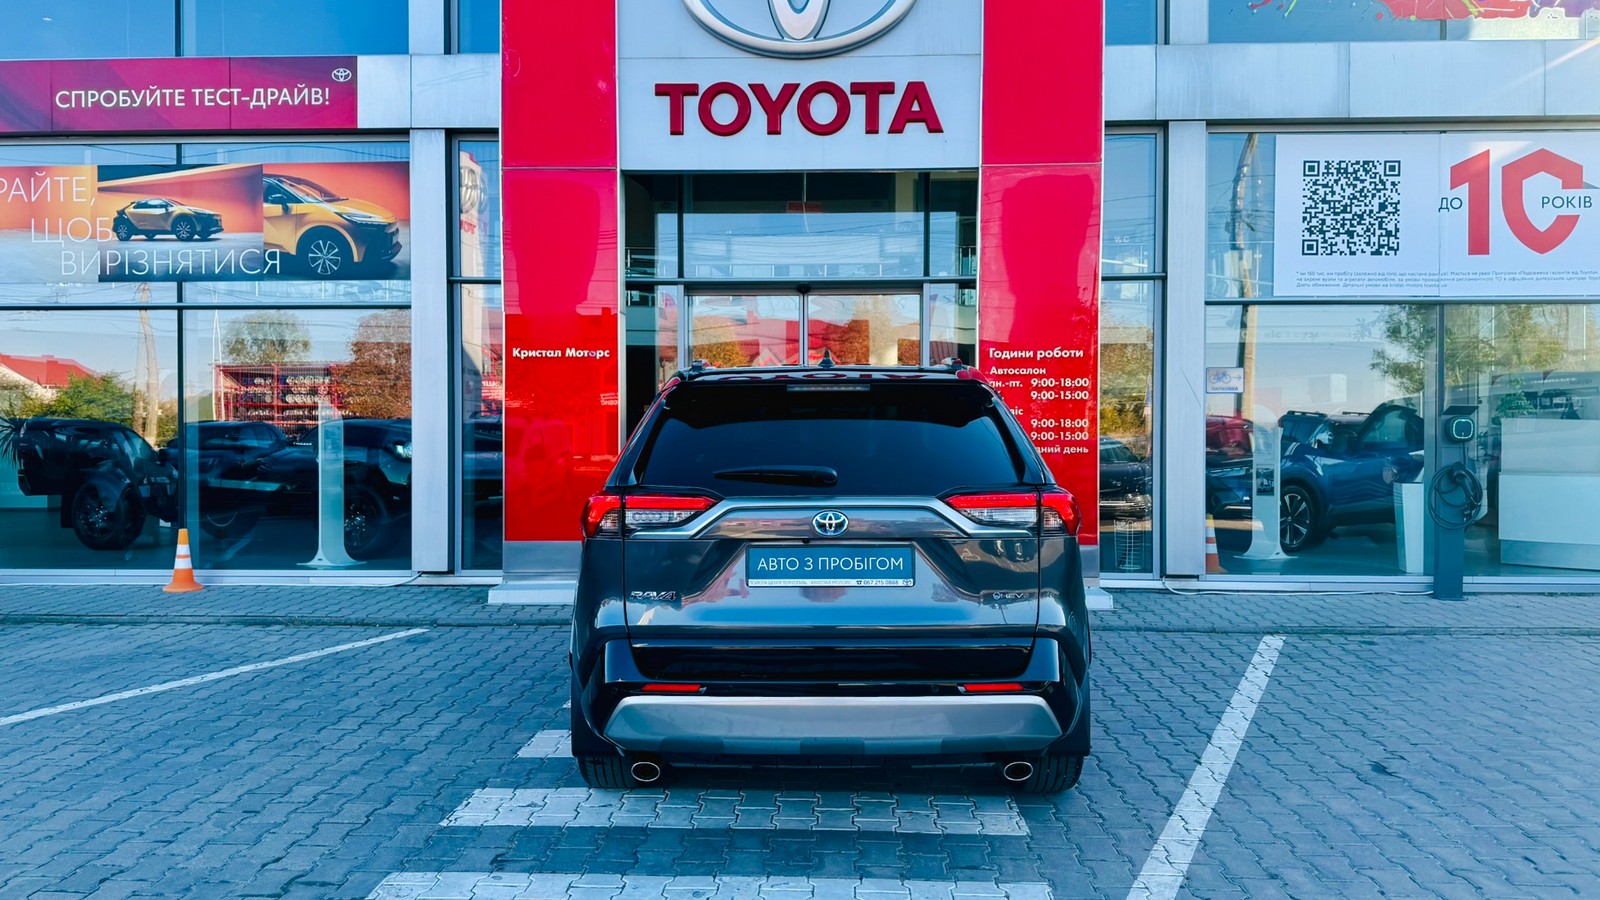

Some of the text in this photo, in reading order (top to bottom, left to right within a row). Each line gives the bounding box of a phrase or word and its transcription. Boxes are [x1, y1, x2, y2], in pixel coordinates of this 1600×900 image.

[55, 84, 330, 109] СПРОБУЙТЕ ТЕСТ-ДРАЙВ!
[654, 80, 944, 136] TOYOTA
[1438, 197, 1463, 212] ДО
[1541, 196, 1592, 208] РОКІВ
[31, 217, 112, 247] ЩОБ
[61, 248, 280, 276] ВИРІЗНЯТИСЯ
[512, 348, 610, 360] Кристал Моторс
[989, 347, 1084, 360] Години роботи
[990, 366, 1046, 375] Автосалон
[1030, 378, 1089, 387] 9:00-18:00
[1030, 391, 1089, 400] 9:00-15:00
[1030, 419, 1089, 428] 9:00-18:00
[1030, 432, 1089, 440] 9:00-15:00
[757, 557, 903, 571] АВТО З ПРОБІГОМ
[630, 591, 676, 600] RAV4
